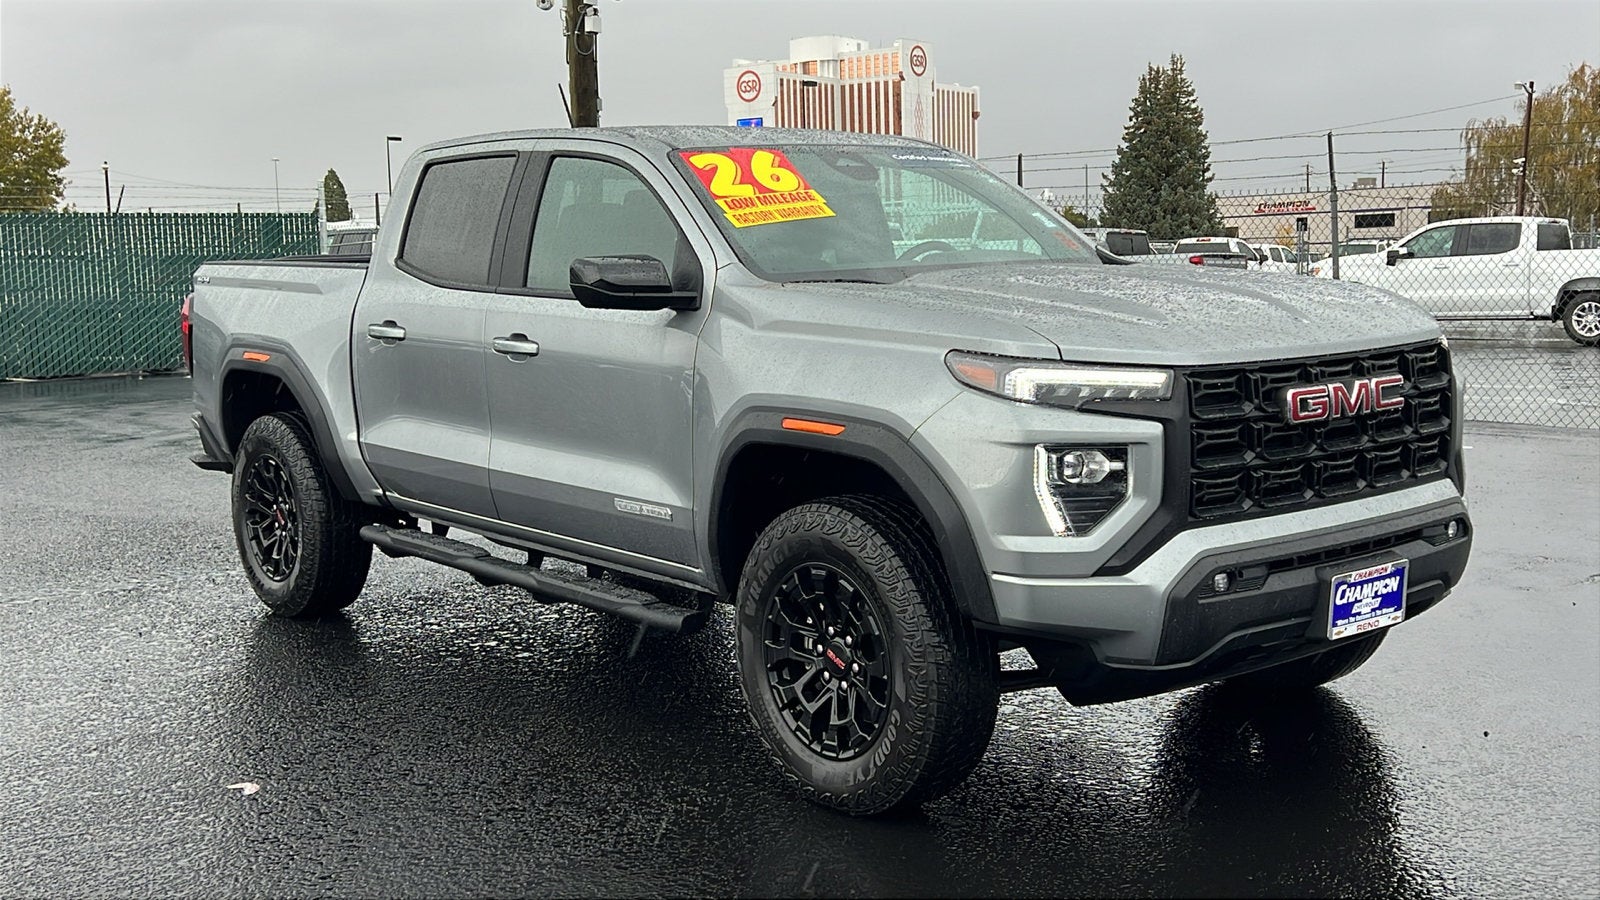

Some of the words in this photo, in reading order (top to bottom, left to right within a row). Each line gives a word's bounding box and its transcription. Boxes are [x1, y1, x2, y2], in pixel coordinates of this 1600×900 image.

[911, 54, 925, 68] GSR
[740, 79, 758, 93] GSR
[689, 150, 803, 197] 26
[724, 196, 758, 211] LOW
[756, 192, 816, 207] MILEAGE
[1257, 200, 1311, 211] CHAMPION
[732, 209, 778, 225] FACTORY
[775, 205, 827, 219] WARRANTY
[1287, 374, 1404, 423] GMC
[1354, 565, 1389, 580] CHAMPION
[1335, 576, 1400, 605] CHAMPION
[1356, 619, 1380, 632] RENO
